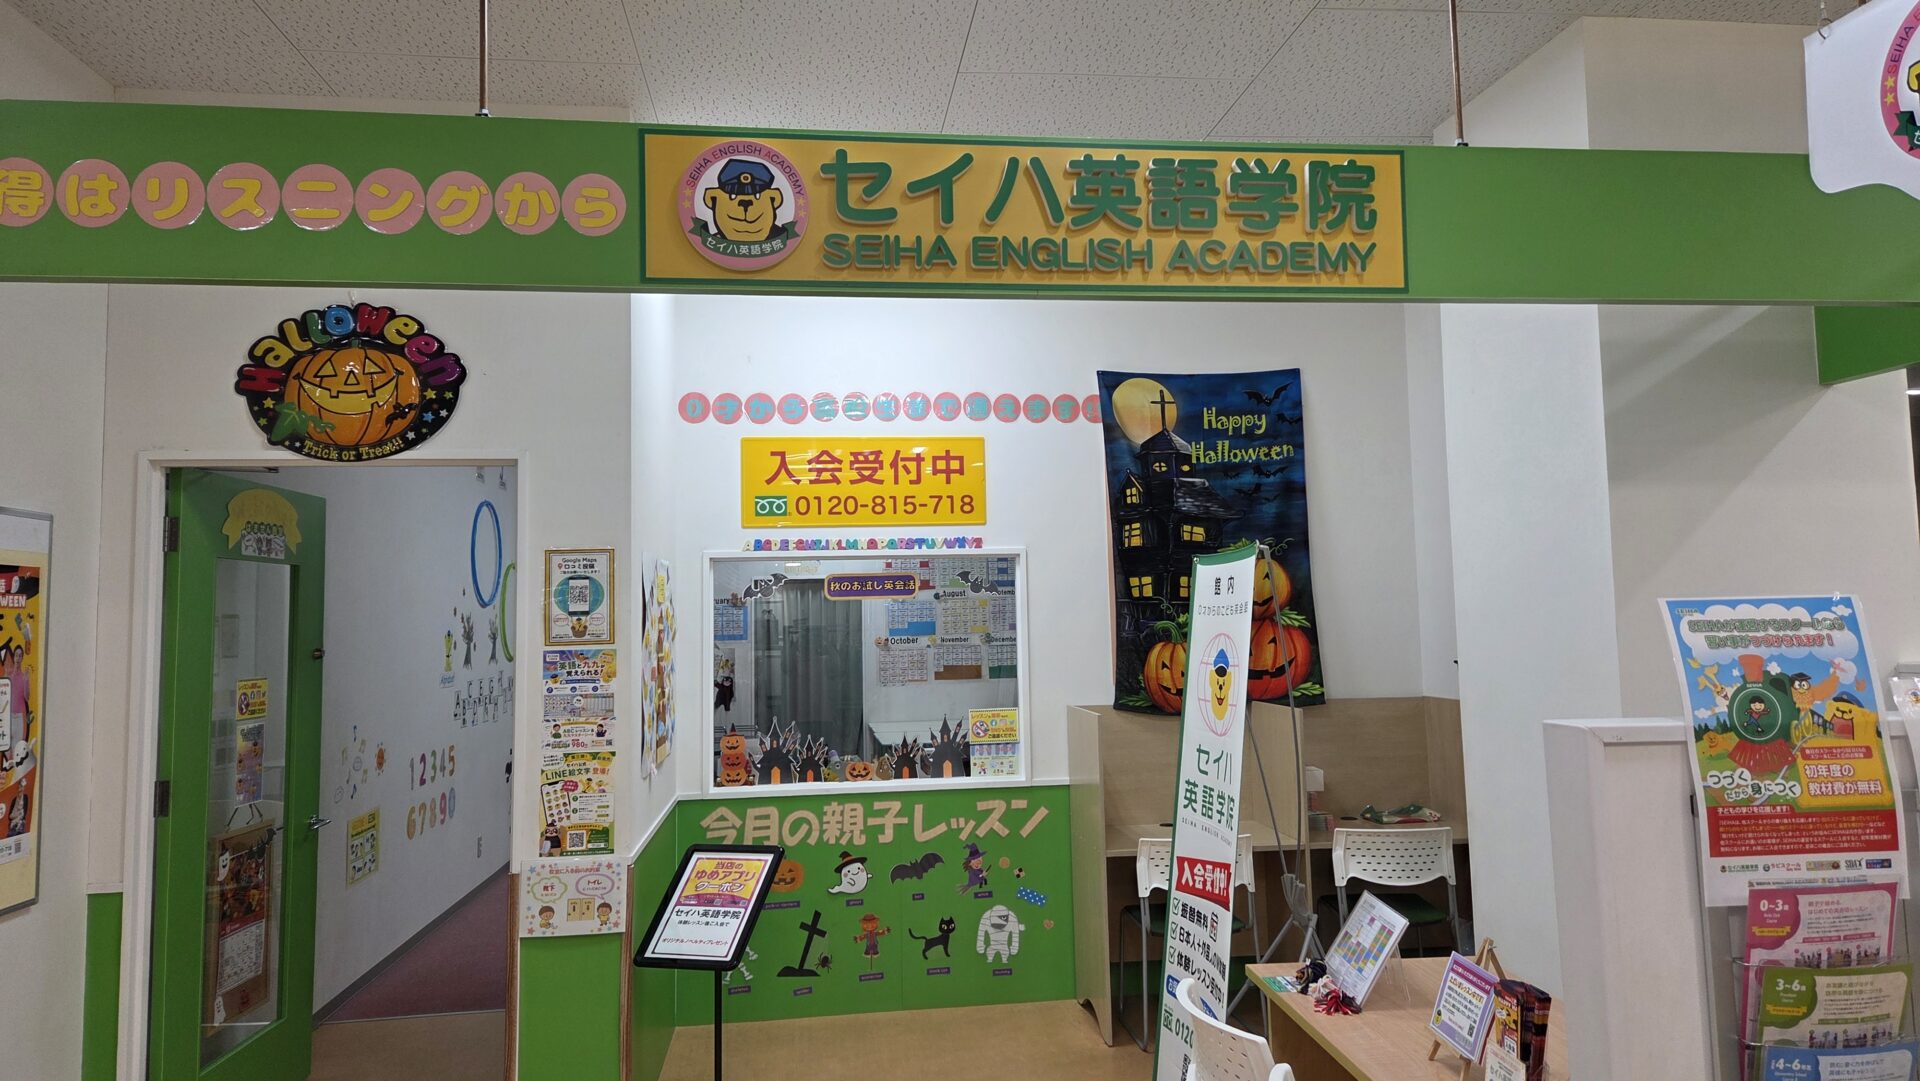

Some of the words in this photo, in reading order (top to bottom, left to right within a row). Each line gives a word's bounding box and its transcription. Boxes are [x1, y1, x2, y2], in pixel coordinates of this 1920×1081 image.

[1888, 26, 1914, 73] SEIHA
[687, 158, 712, 187] SEIHA
[711, 145, 762, 160] ENGLISH
[764, 151, 804, 196] ACADEMY
[820, 149, 1377, 231] セイハ英語学院
[706, 238, 783, 254] セイハ英語学院
[822, 233, 957, 269] SEIHA
[971, 235, 1153, 272] ENGLISH
[1166, 240, 1376, 273] ACADEMY
[1203, 406, 1266, 435] Happy
[303, 439, 338, 459] Trick
[342, 450, 355, 460] or
[1191, 441, 1294, 464] Halloween
[765, 449, 965, 485] 入会受付中
[795, 494, 975, 515] 0120-815-718
[831, 579, 915, 590] 秋のお試し英会話
[943, 590, 966, 598] August
[890, 637, 918, 645] October
[1196, 744, 1232, 785] セイハ
[1805, 764, 1854, 777] 初年度の
[1709, 770, 1749, 786] つづく
[1808, 782, 1882, 796] 教材費が無料
[1184, 779, 1234, 831] 英語学院
[700, 799, 1050, 847] 今月の親子レッスン
[695, 870, 756, 881] ゆめアプリ
[715, 861, 743, 870] 当店の
[695, 881, 745, 892] クーポン
[1181, 861, 1227, 896] 入会受付中!
[675, 908, 741, 920] セイハ英語学院
